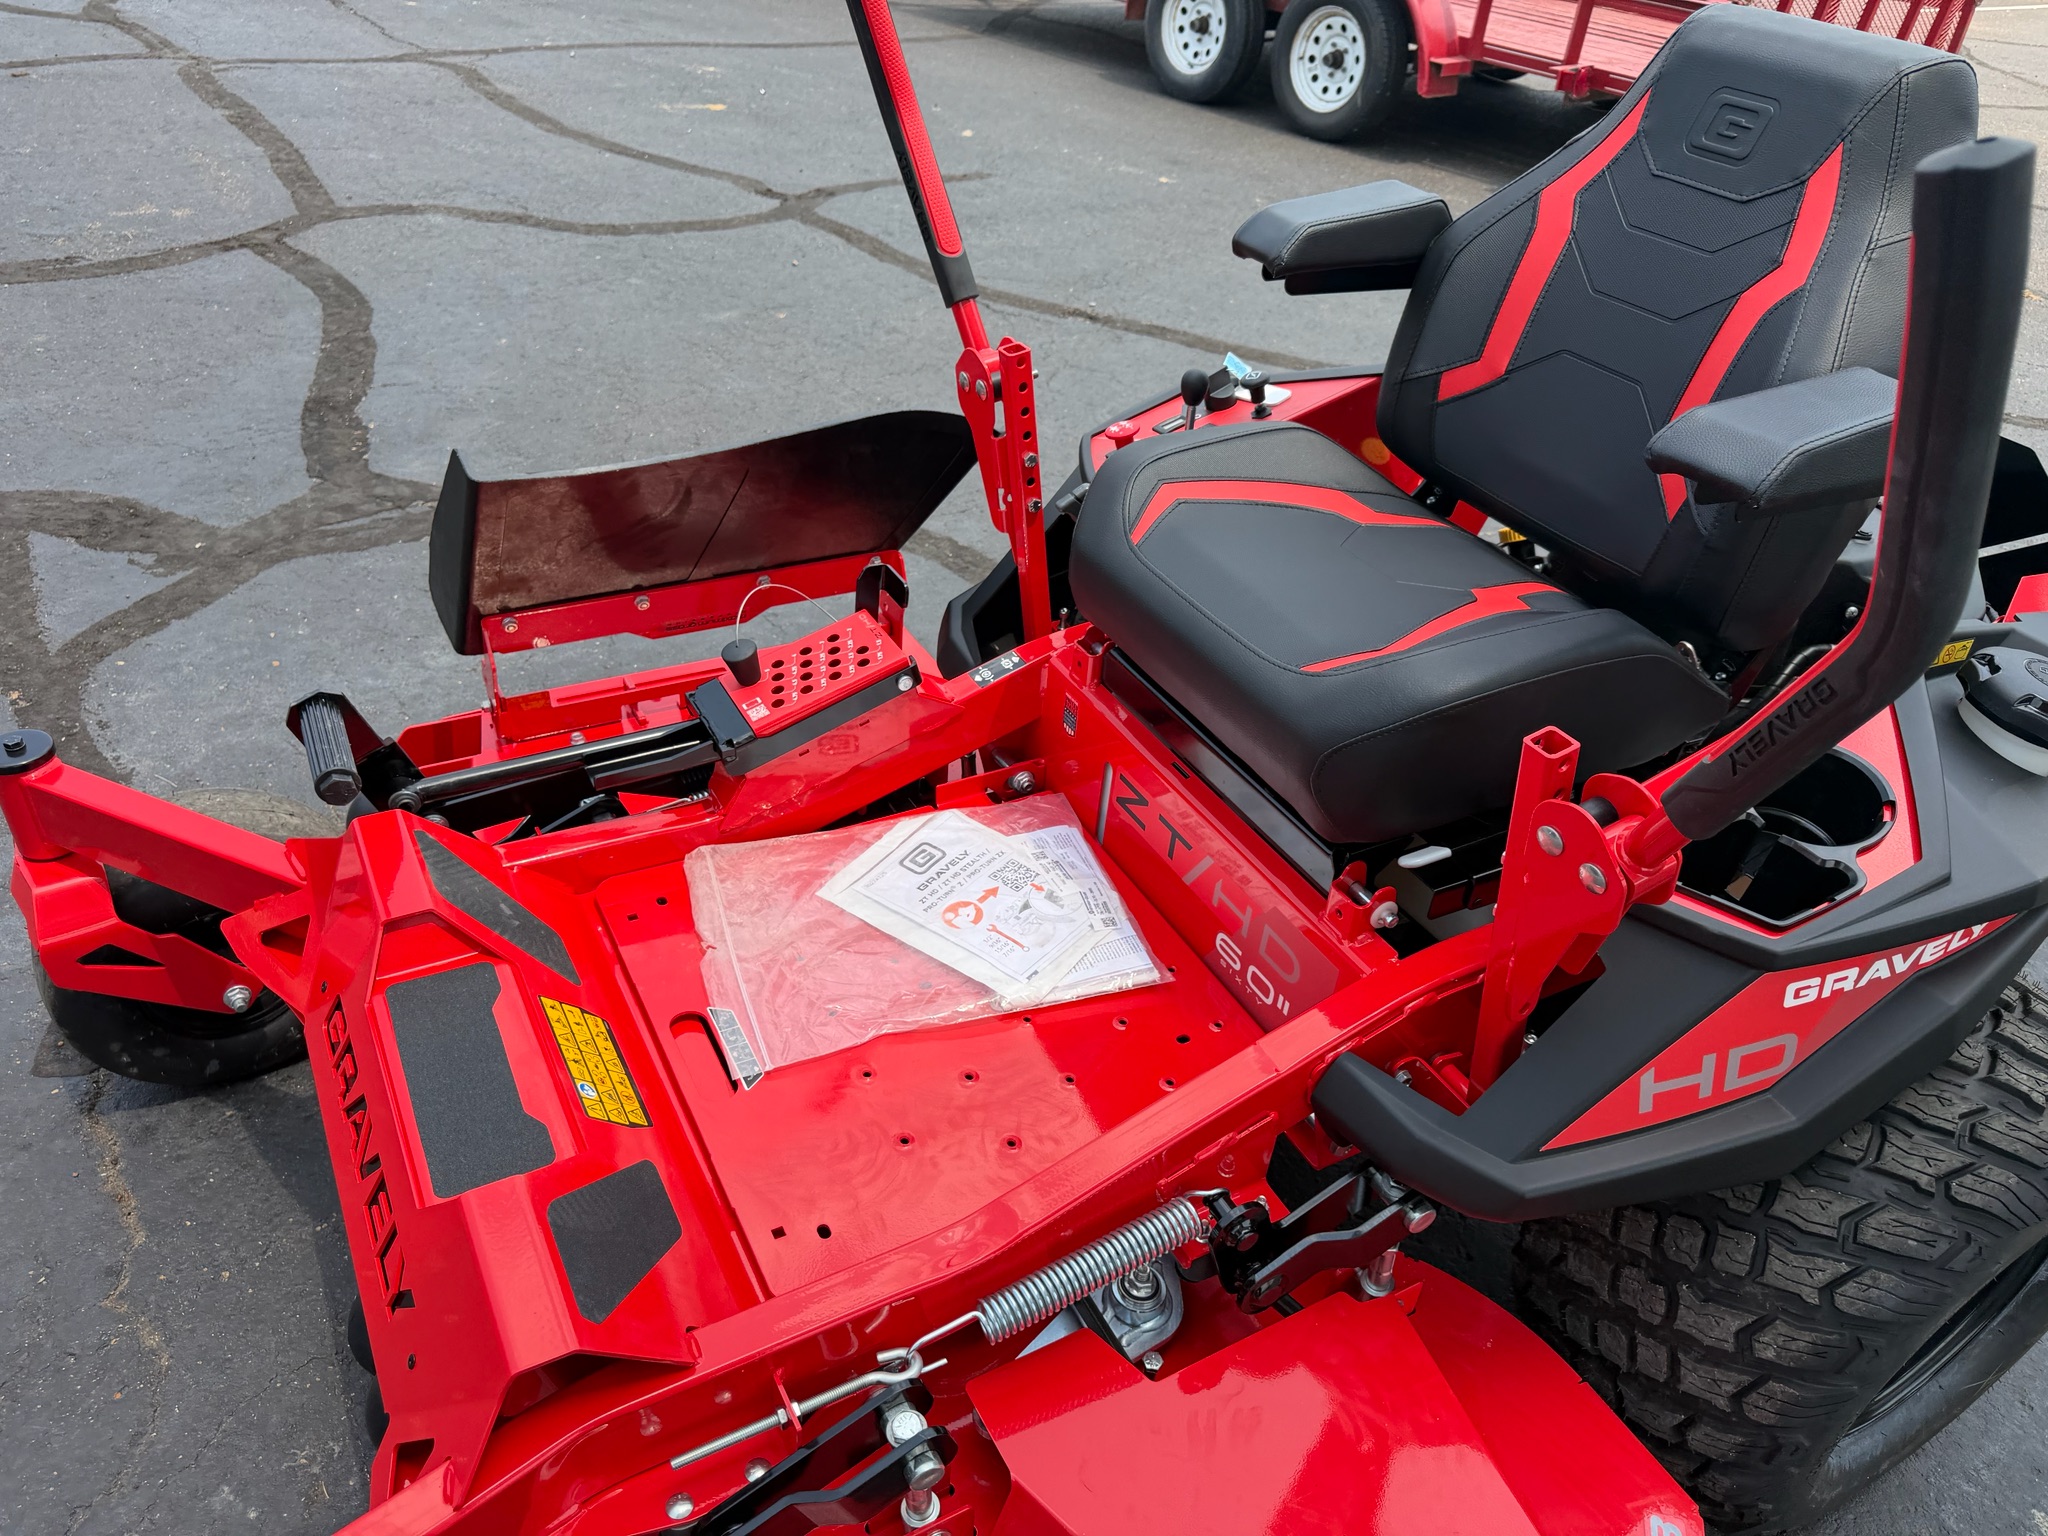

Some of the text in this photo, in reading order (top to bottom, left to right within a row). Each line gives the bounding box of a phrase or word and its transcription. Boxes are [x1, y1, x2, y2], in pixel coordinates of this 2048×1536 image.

[1728, 676, 1840, 778] GRAVELY
[916, 850, 970, 892] GRAVELY
[918, 896, 928, 904] ZT
[928, 888, 939, 897] HD
[942, 879, 951, 887] ZT
[950, 872, 962, 880] HD
[960, 850, 986, 872] STEALTH
[966, 856, 997, 879] PRO-TURN
[995, 850, 1005, 858] ZX
[1220, 958, 1262, 1004] SIXTY
[1782, 921, 1990, 1009] GRAVELY
[1638, 1032, 1799, 1114] HD
[321, 993, 416, 1323] GRAVELY
